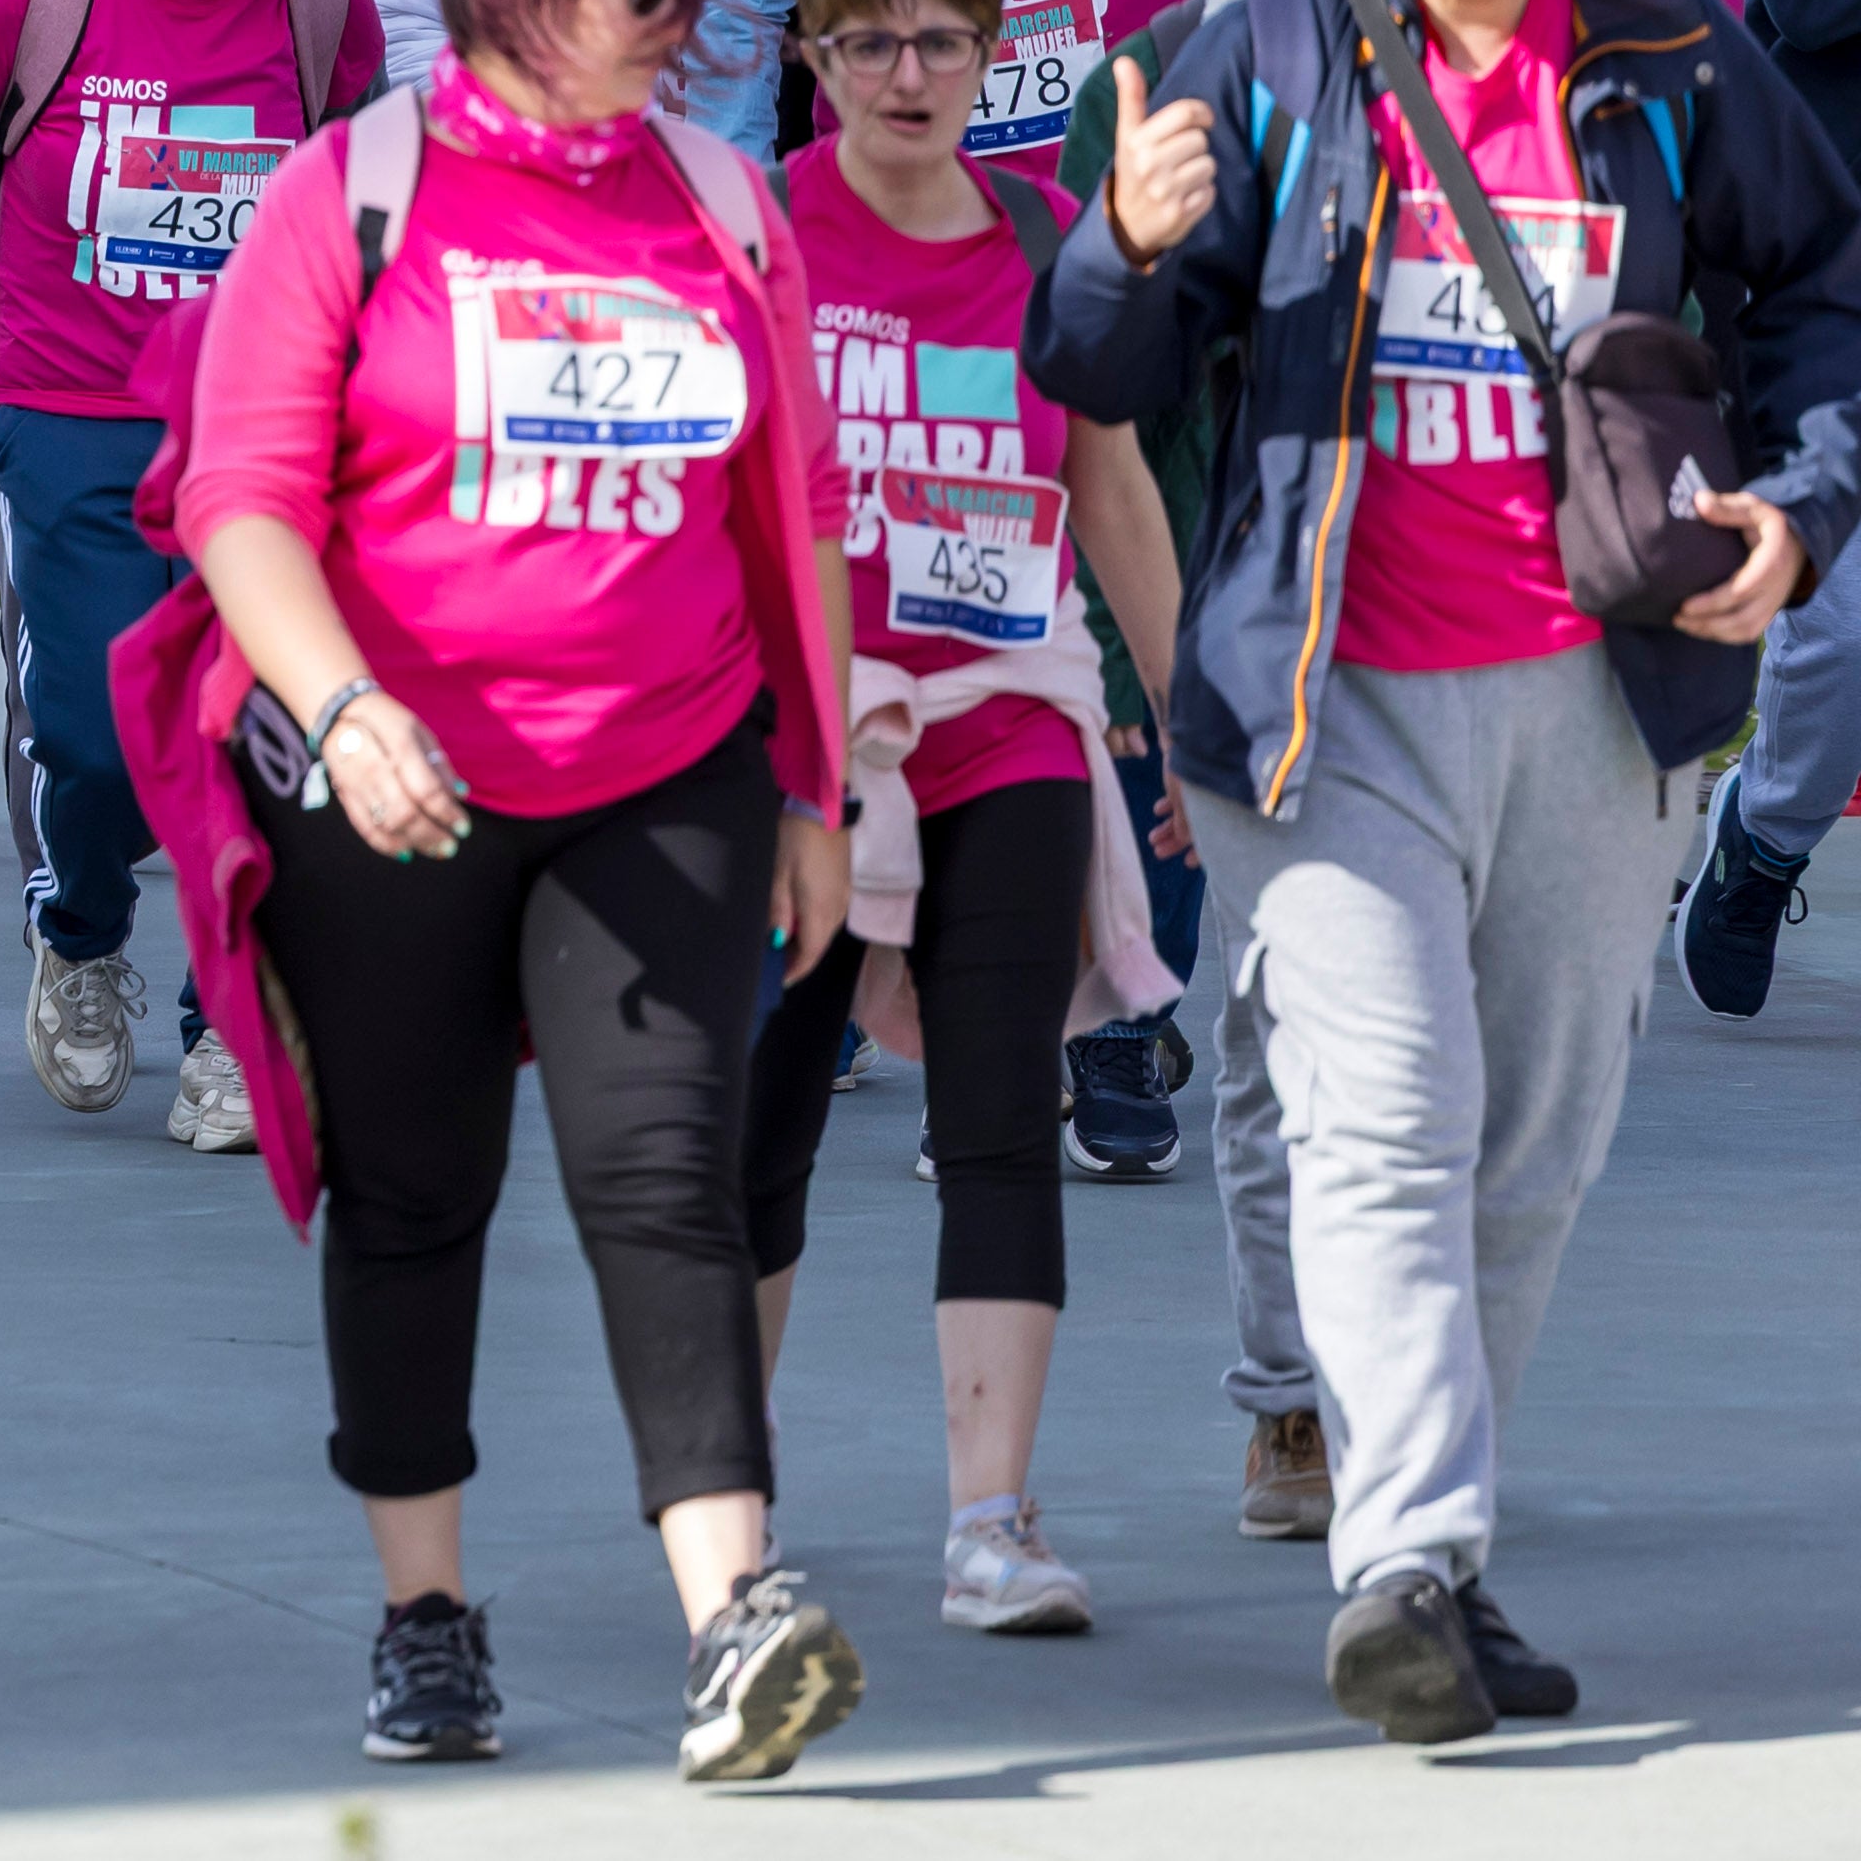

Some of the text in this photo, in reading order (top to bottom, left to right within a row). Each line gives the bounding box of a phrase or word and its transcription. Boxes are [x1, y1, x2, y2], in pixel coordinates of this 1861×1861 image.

[1015, 27, 1078, 60] MUJER
[81, 75, 168, 101] SOMOS
[179, 150, 197, 171] VI
[815, 303, 910, 344] SOMOS
[1427, 275, 1559, 343] 44
[548, 351, 681, 411] 427
[928, 536, 1008, 605] 435
